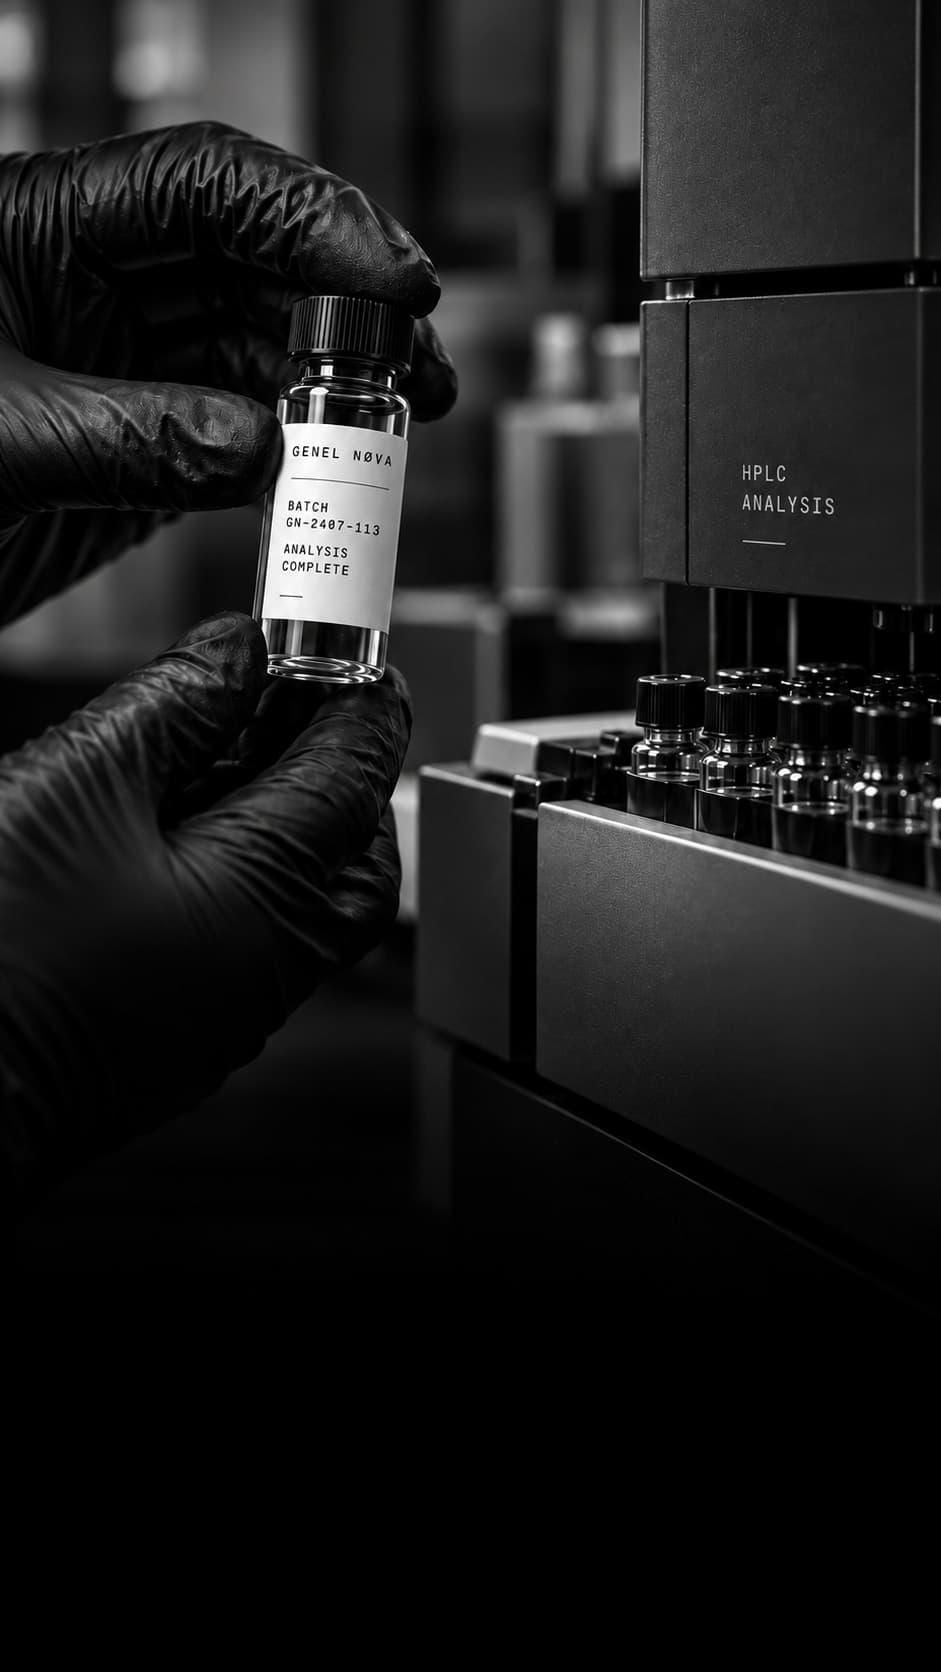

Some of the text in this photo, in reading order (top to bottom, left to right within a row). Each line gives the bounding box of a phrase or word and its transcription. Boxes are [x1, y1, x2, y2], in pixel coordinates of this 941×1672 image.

[292, 446, 340, 459] GENEL
[742, 464, 786, 482] HPLC
[288, 500, 329, 513] BATCH
[742, 494, 835, 515] ANALYSIS
[286, 517, 381, 536] GN-2407-113
[283, 543, 348, 559] ANALYSIS
[282, 560, 350, 576] COMPLETE
